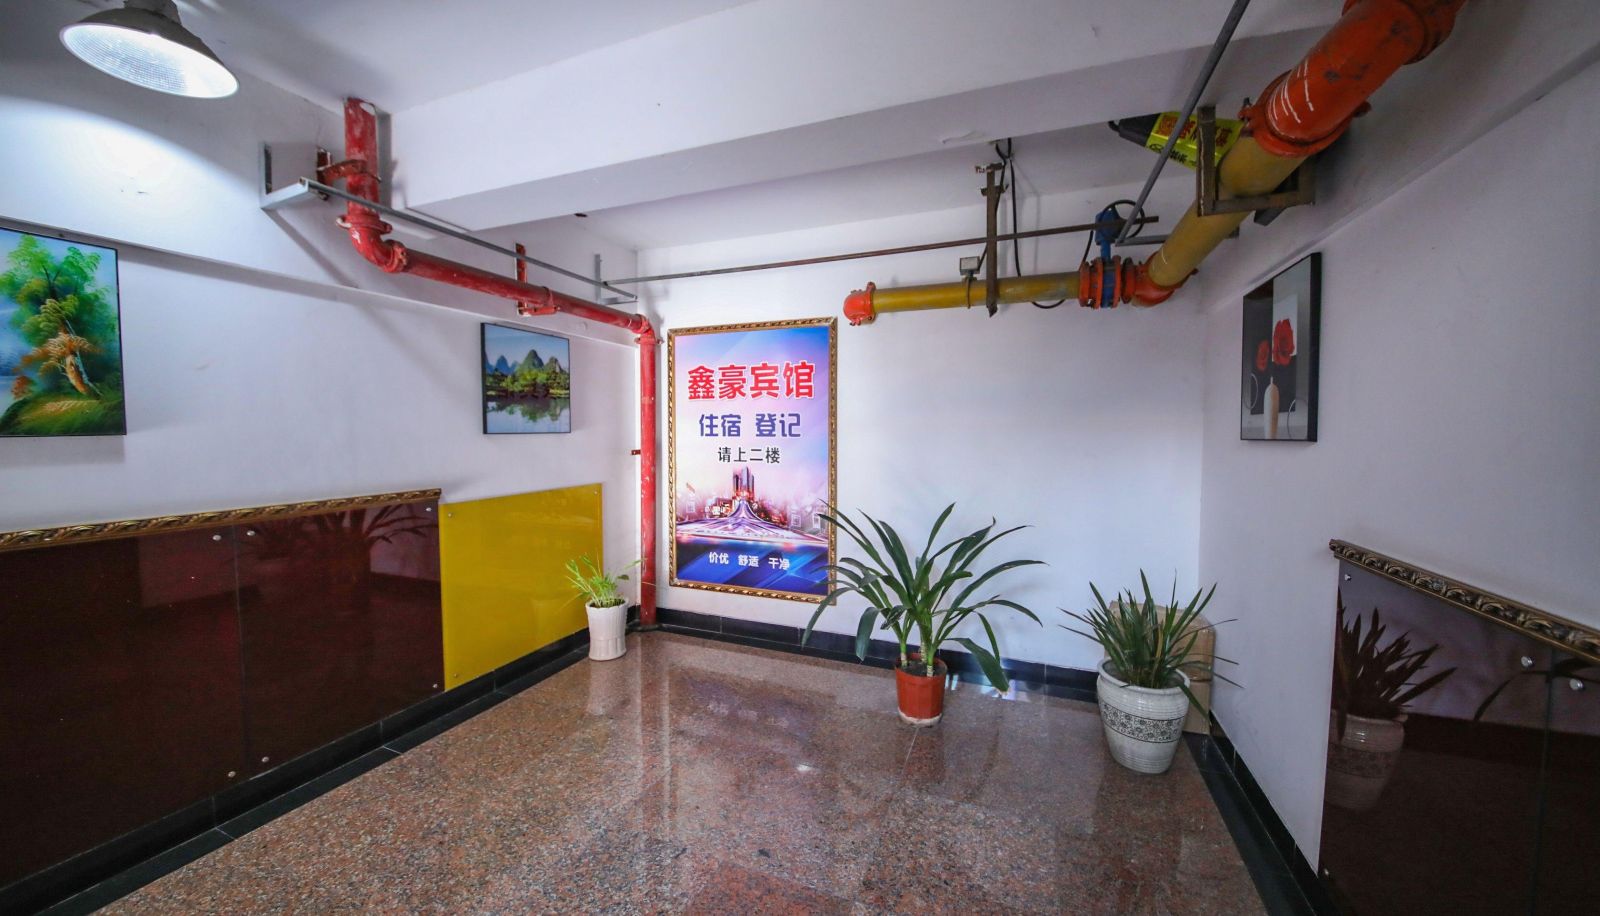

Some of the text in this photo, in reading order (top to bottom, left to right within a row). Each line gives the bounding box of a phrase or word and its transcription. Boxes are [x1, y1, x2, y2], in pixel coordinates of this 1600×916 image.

[688, 362, 814, 400] 鑫豪宾馆
[699, 413, 801, 437] 住宿 登记
[717, 447, 781, 463] 请上二楼
[709, 552, 790, 570] 价优 舒适 干净
